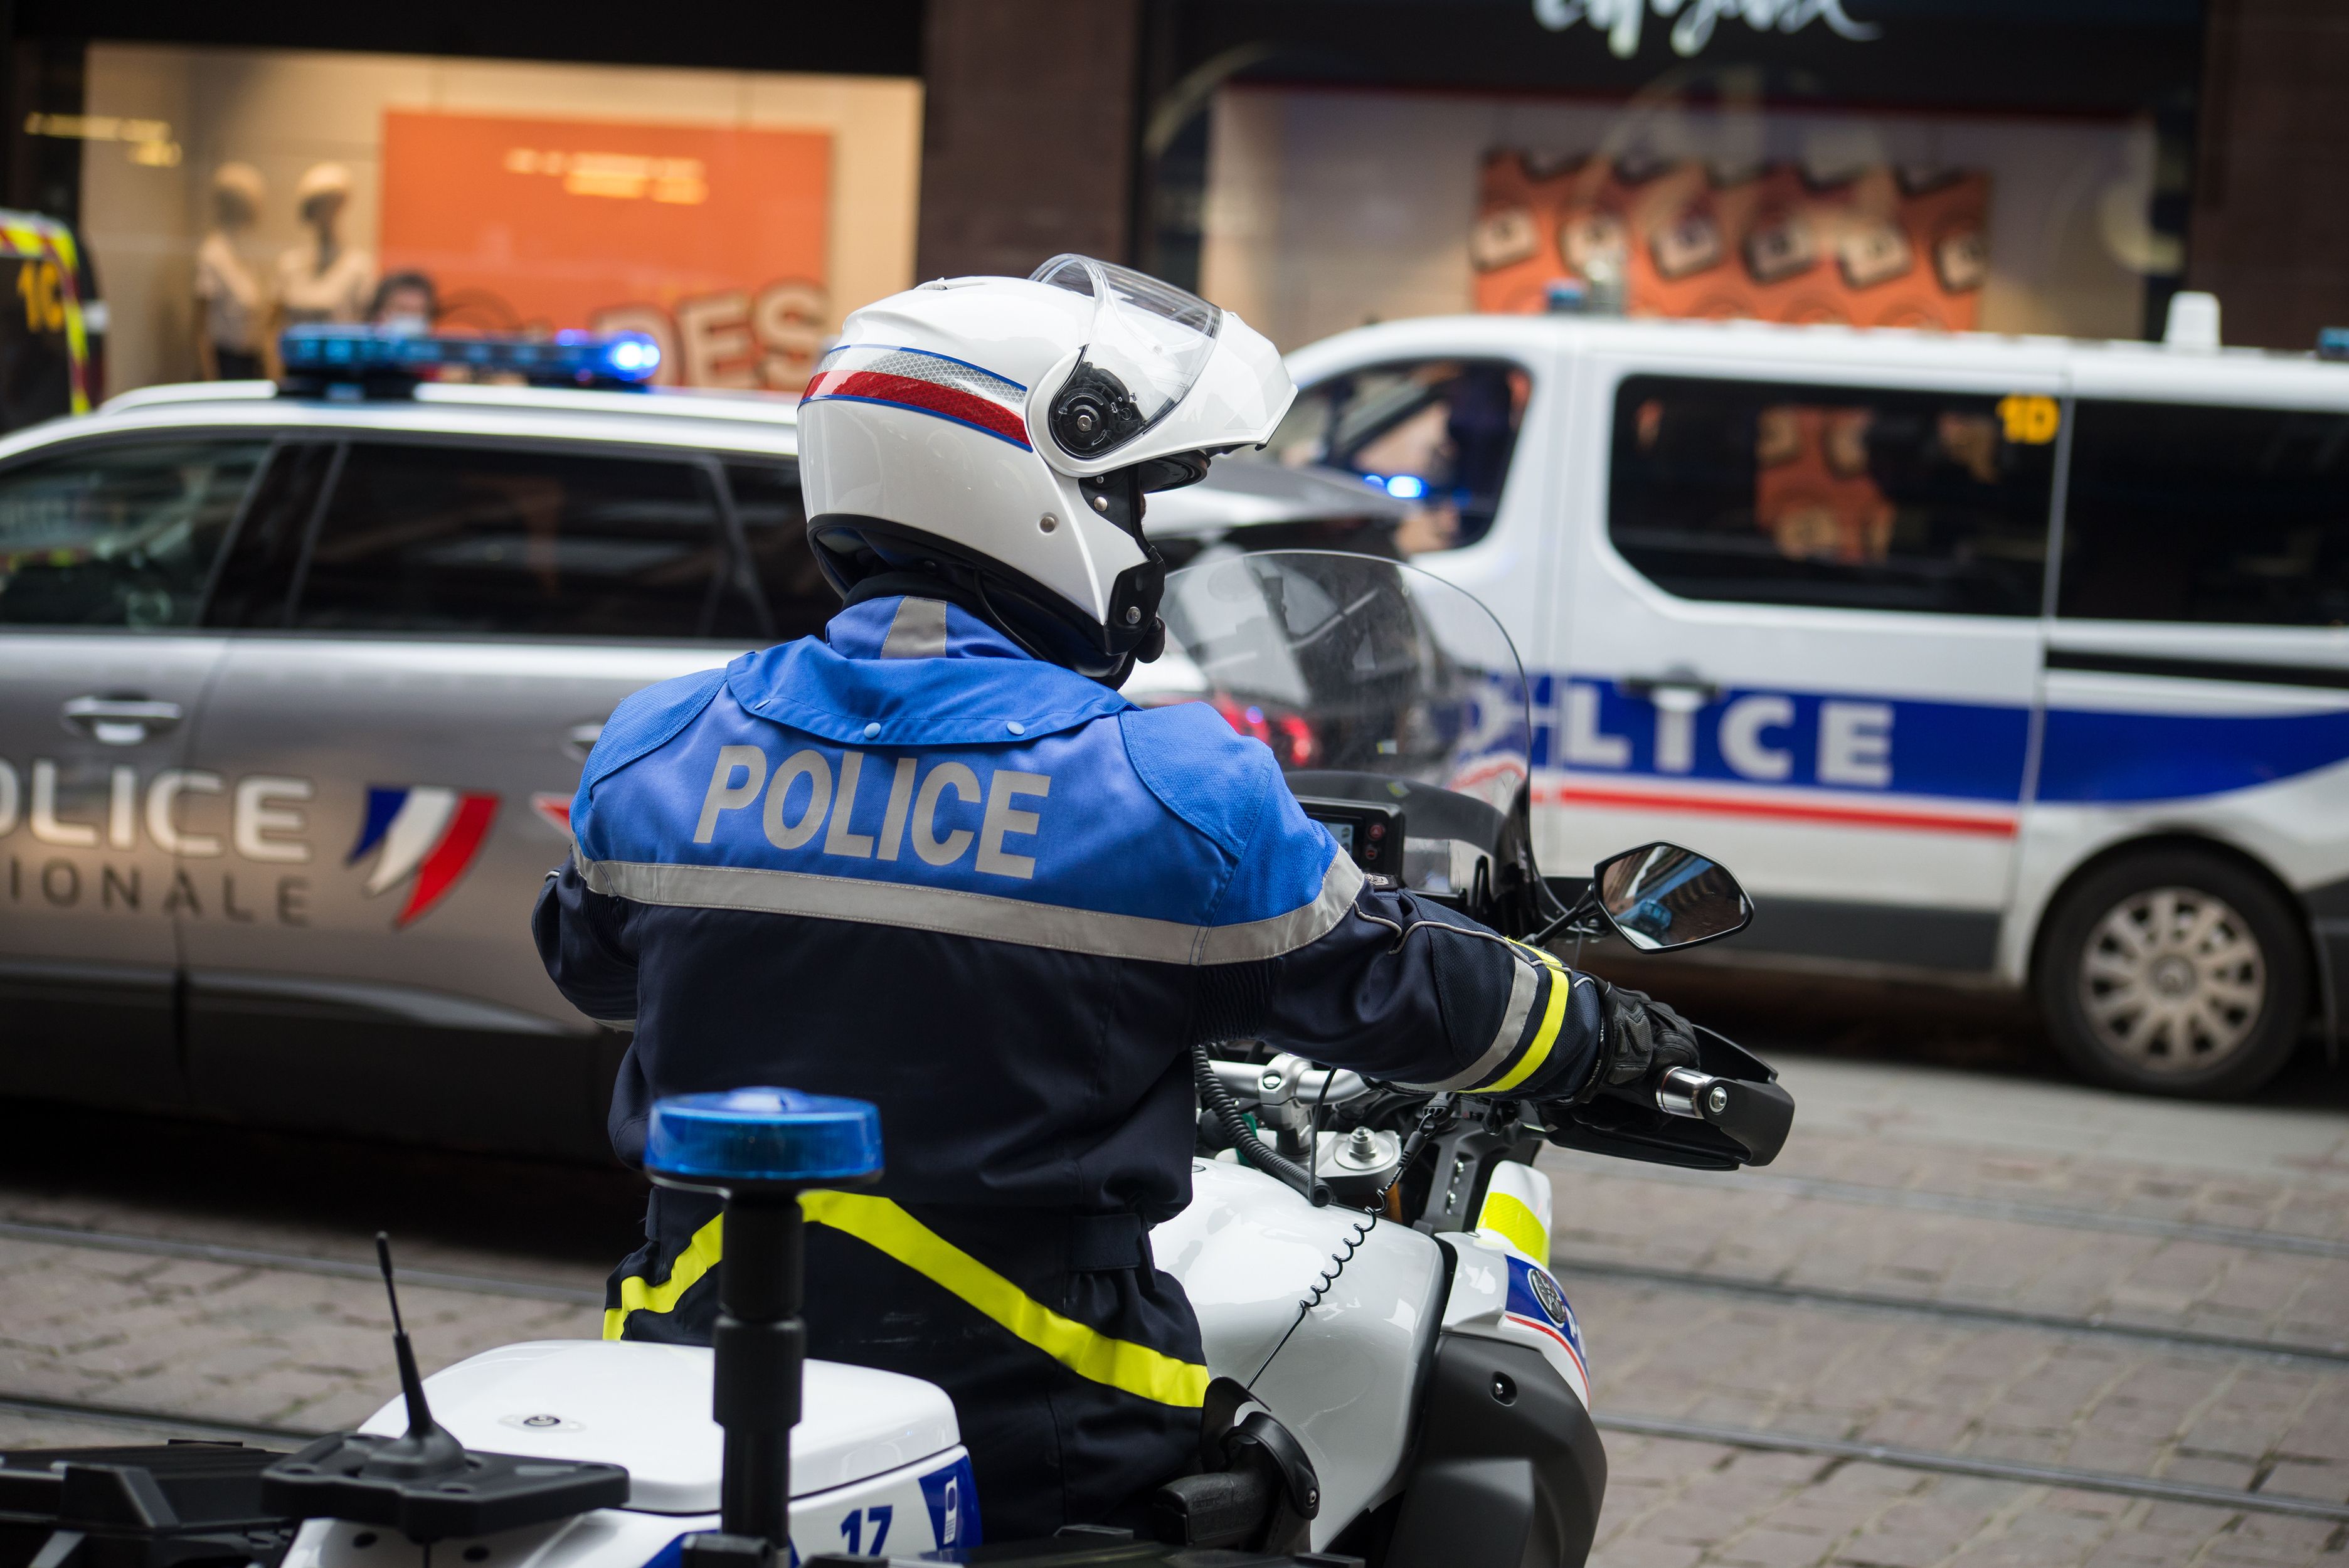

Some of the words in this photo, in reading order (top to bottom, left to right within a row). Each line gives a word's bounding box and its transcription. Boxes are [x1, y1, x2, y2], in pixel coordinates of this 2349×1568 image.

[1468, 682, 1894, 788] LICE
[0, 758, 312, 863] LICE
[692, 744, 1051, 880] POLICE
[840, 1505, 894, 1557] 17
